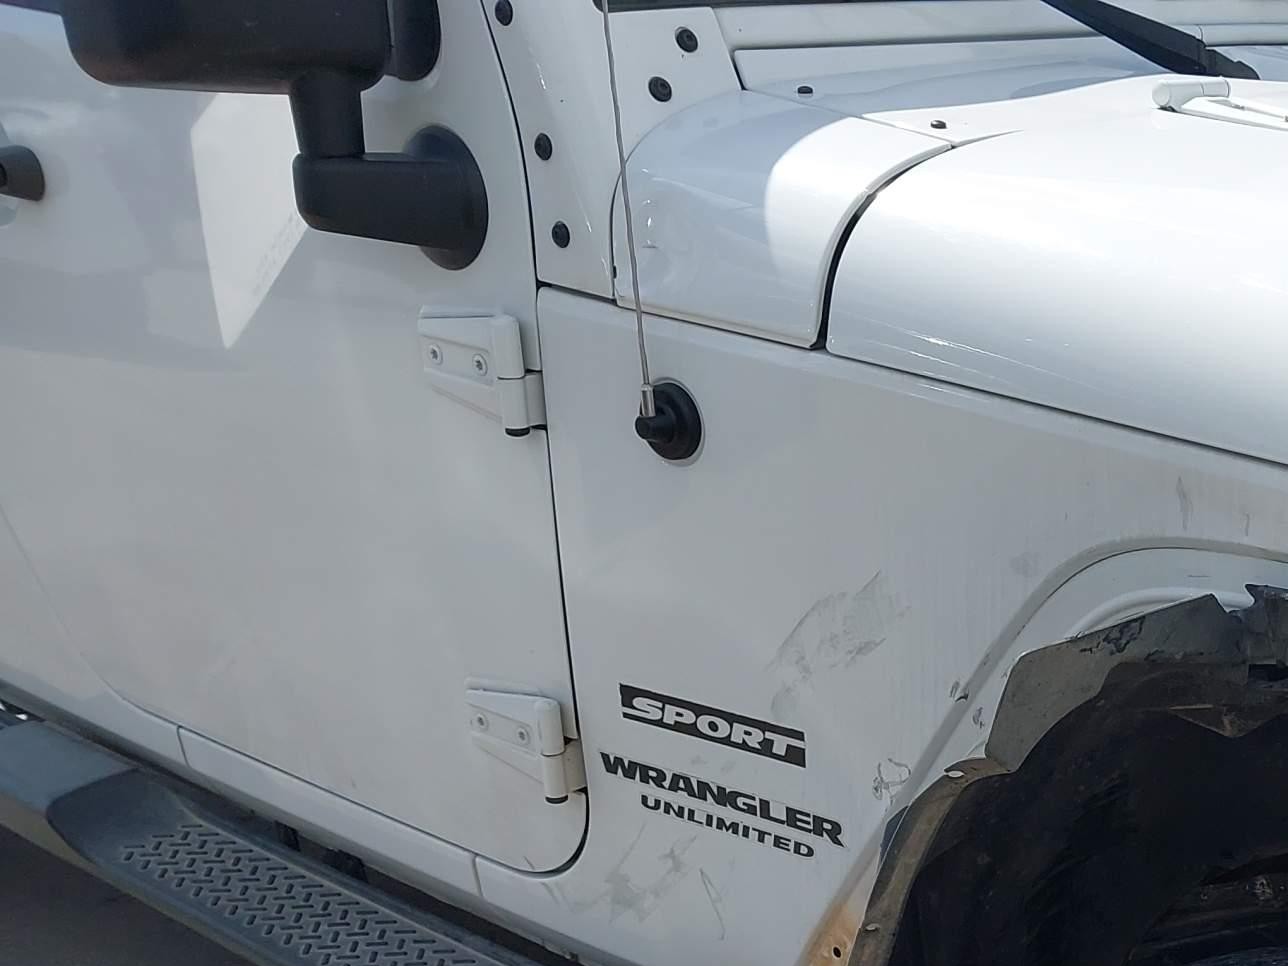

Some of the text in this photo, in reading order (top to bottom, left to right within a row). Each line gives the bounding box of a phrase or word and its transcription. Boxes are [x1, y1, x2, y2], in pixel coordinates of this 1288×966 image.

[632, 697, 806, 756] SPORT
[600, 752, 845, 848] WRANGLER
[641, 795, 814, 857] UNLIMITED
